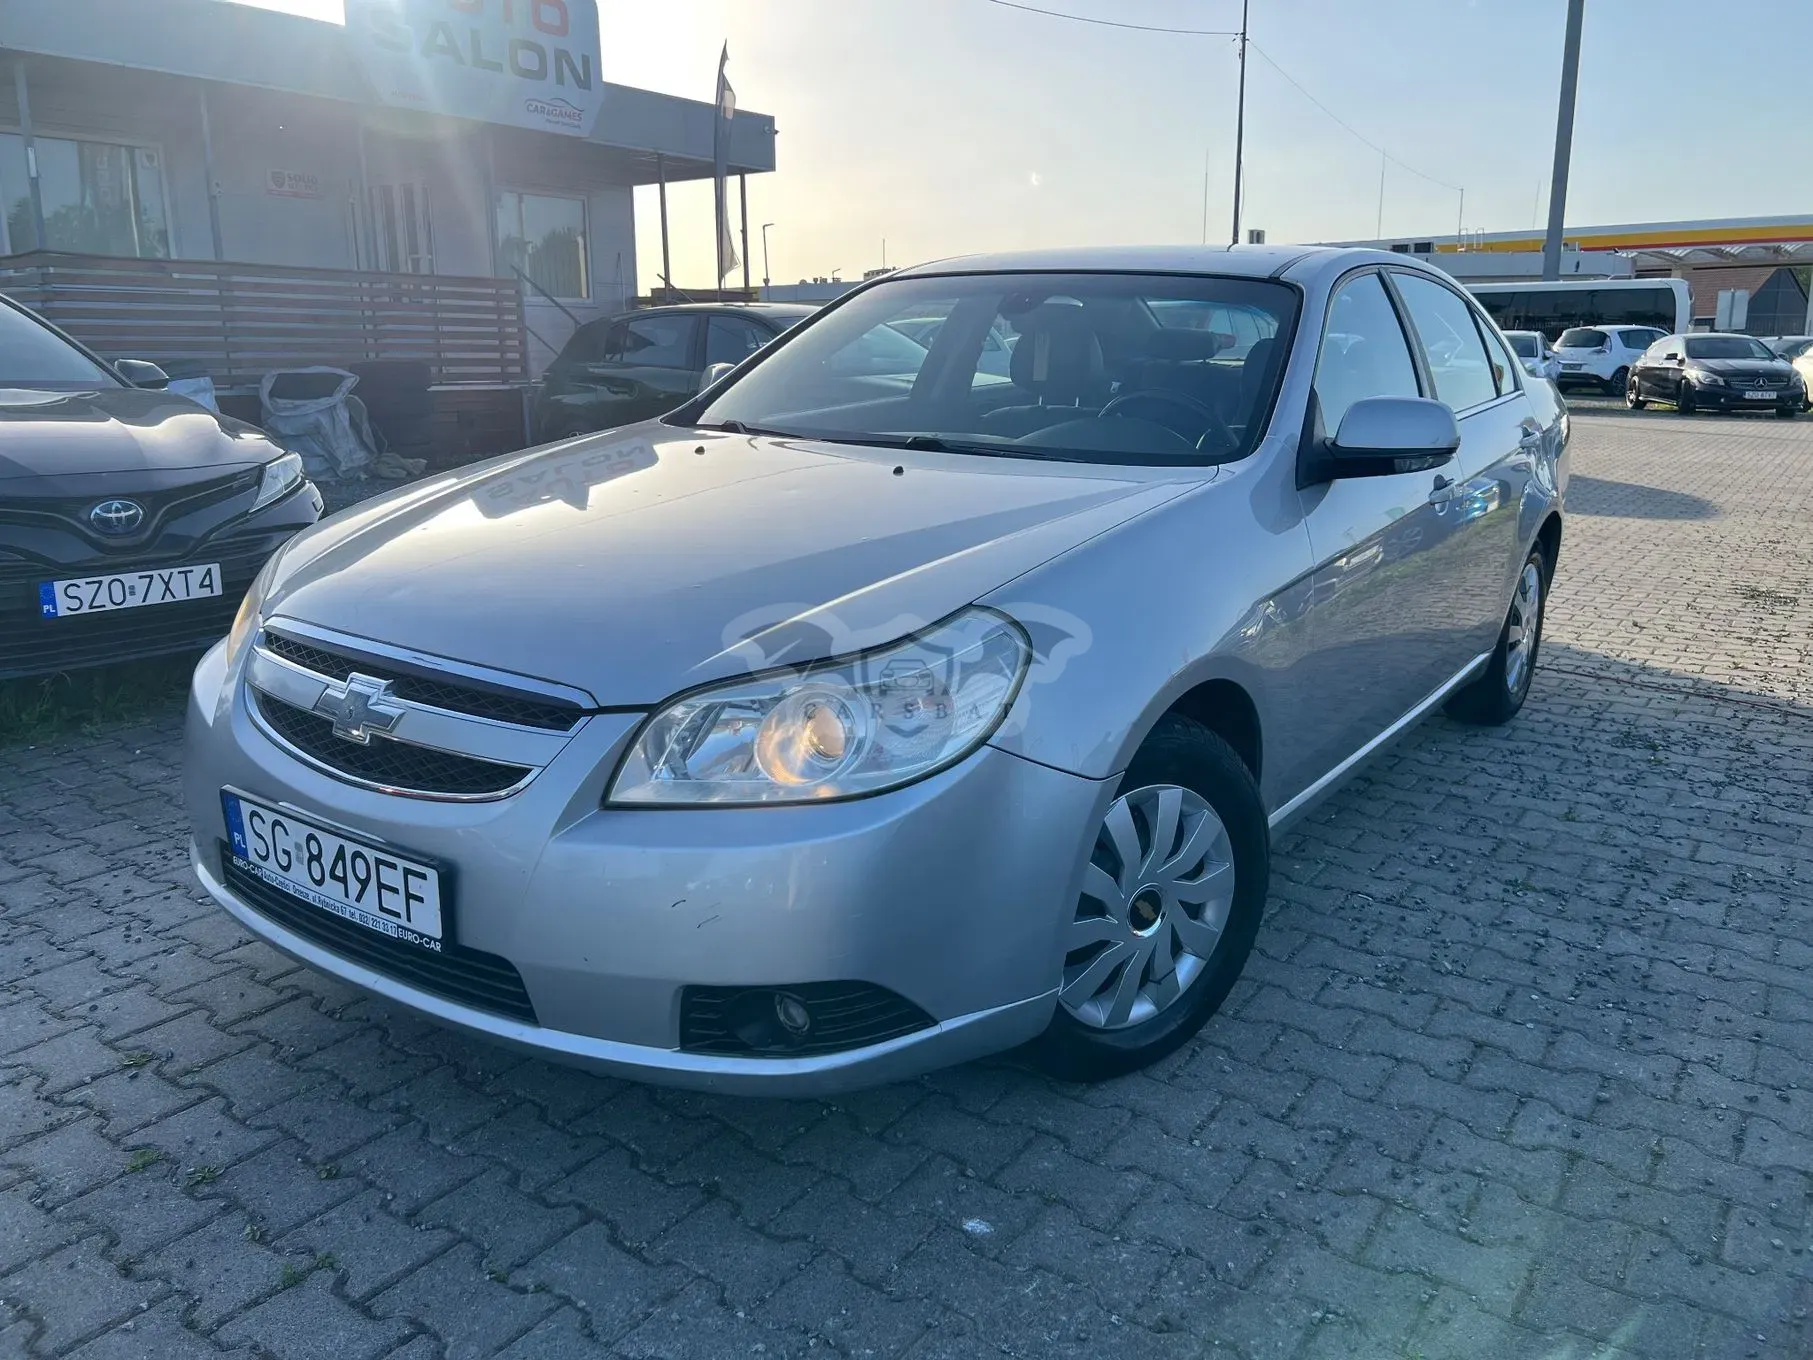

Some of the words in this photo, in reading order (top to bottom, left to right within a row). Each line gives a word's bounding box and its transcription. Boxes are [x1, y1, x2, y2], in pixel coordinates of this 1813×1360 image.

[369, 8, 592, 92] SALON
[137, 567, 214, 603] 7XT4
[43, 604, 56, 614] PL
[234, 831, 246, 849] PL
[232, 855, 263, 878] EURO-CAR
[249, 809, 292, 873] SG
[305, 832, 429, 923] 849EF
[398, 928, 442, 953] EURO-CAR
